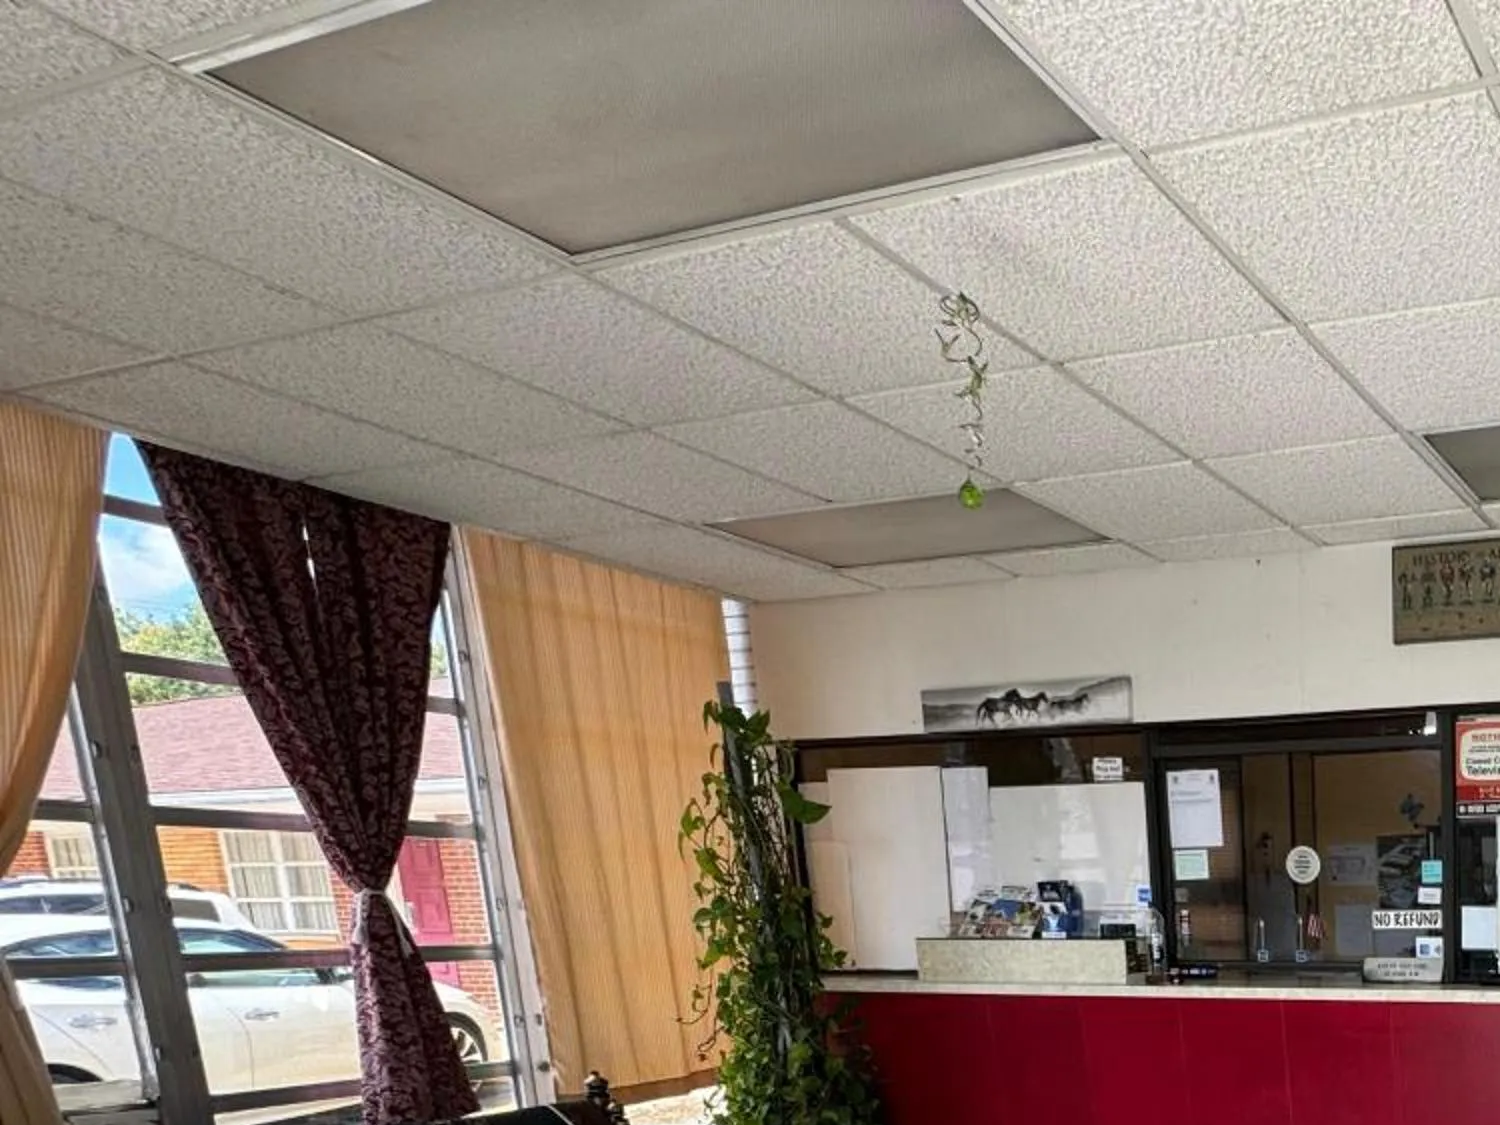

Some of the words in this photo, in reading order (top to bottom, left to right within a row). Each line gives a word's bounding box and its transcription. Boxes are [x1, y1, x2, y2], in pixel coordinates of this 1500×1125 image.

[1412, 548, 1472, 567] HISTORY
[1375, 913, 1391, 927] NO
[1394, 911, 1439, 926] REFUND
